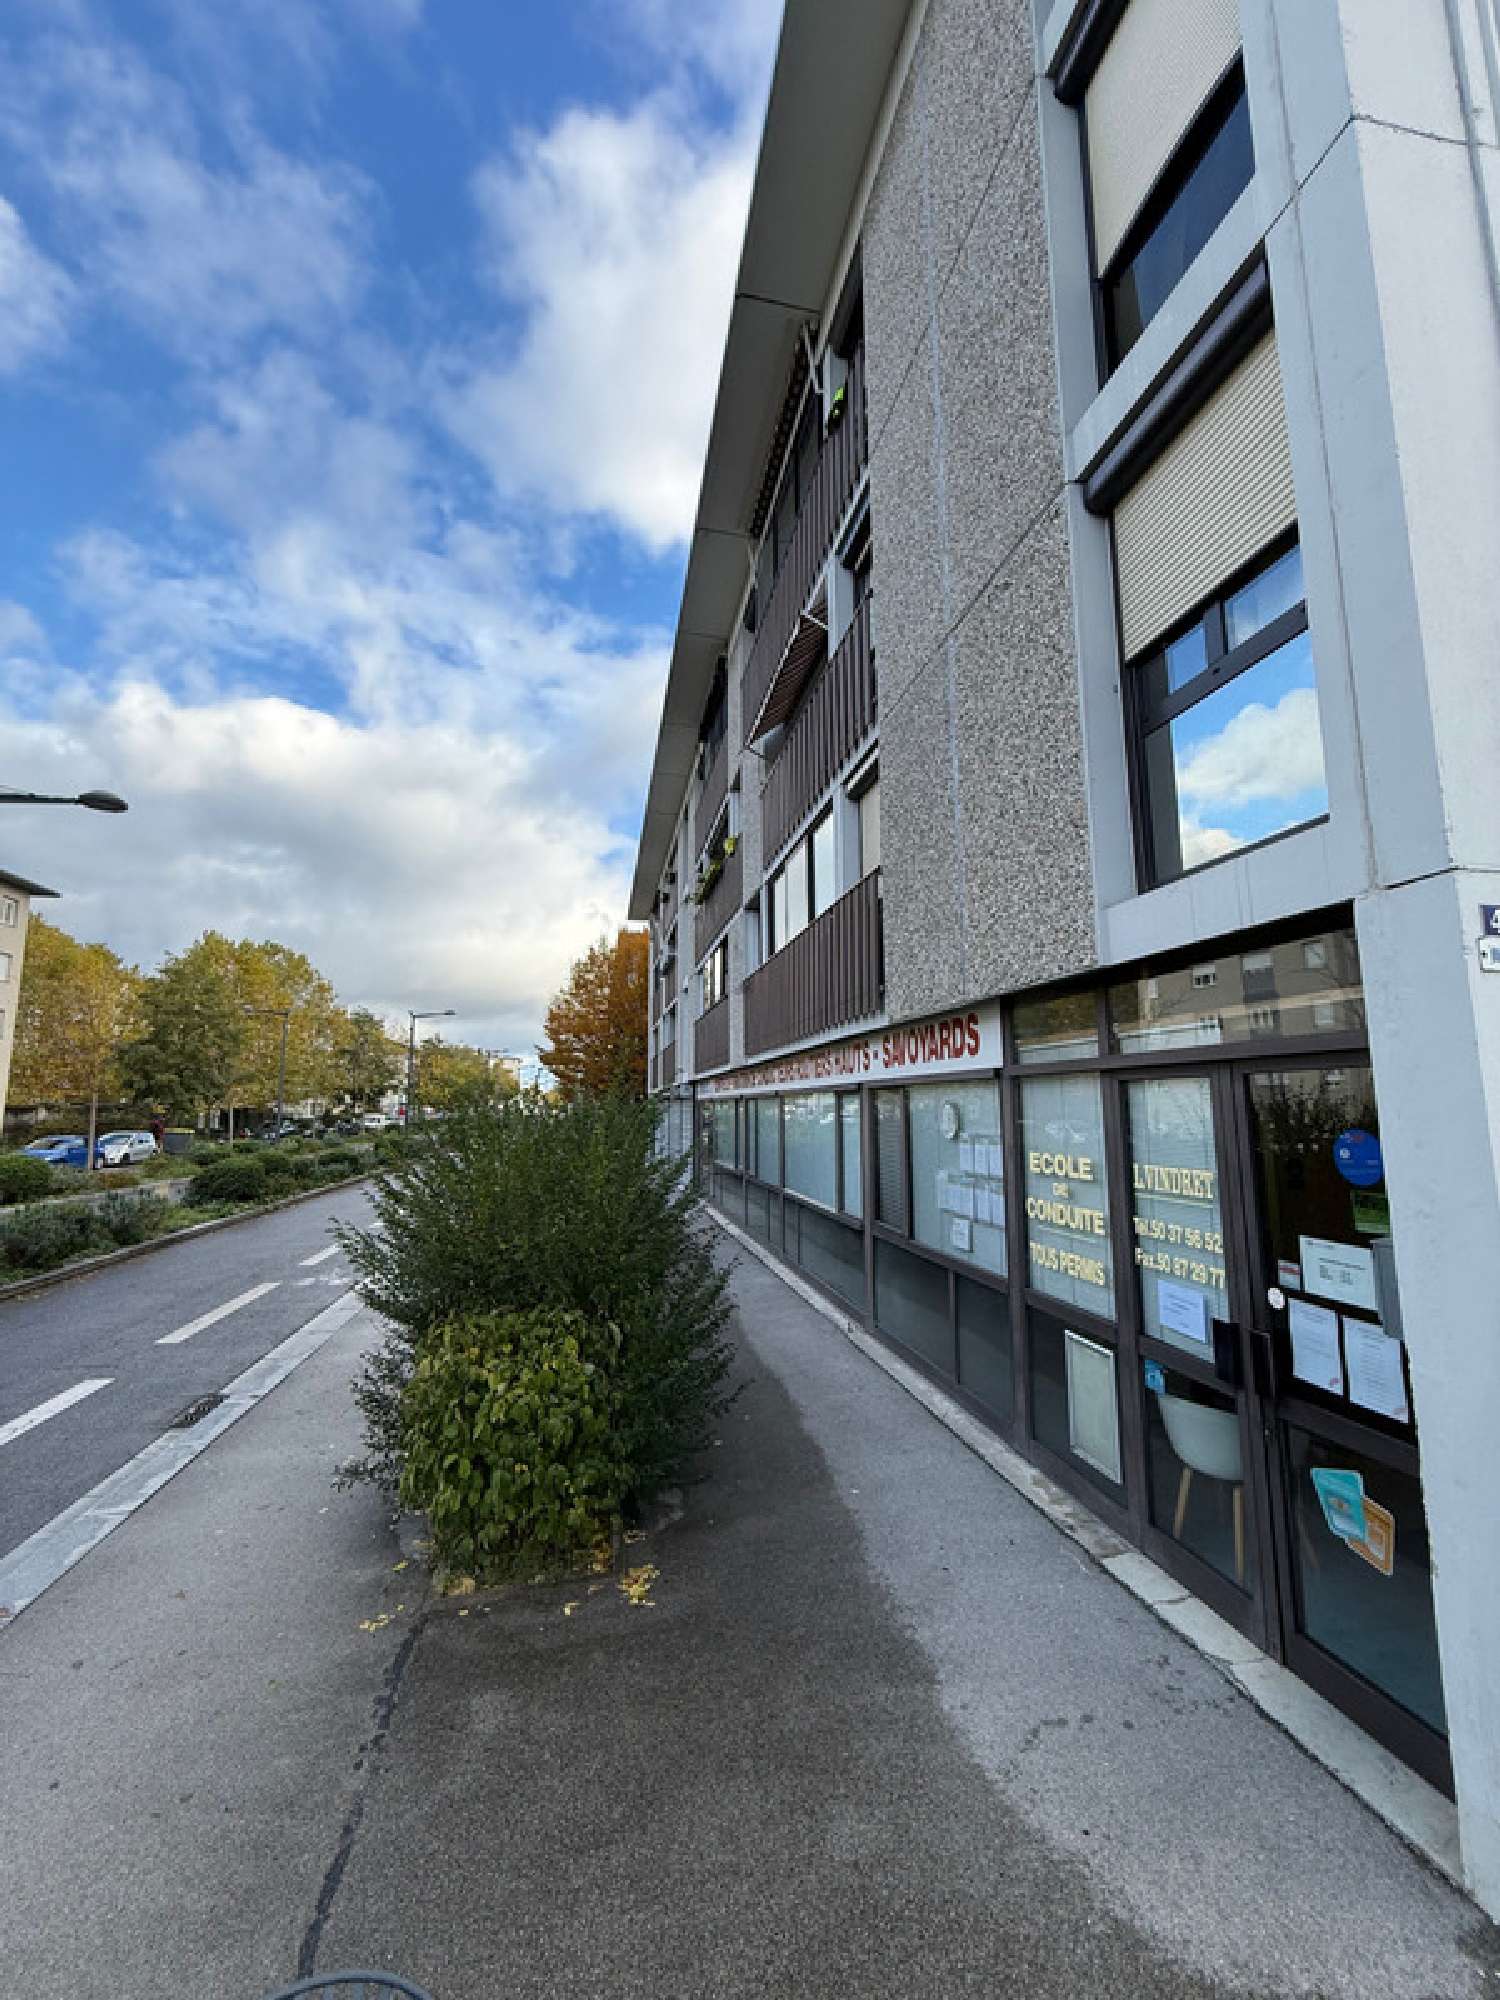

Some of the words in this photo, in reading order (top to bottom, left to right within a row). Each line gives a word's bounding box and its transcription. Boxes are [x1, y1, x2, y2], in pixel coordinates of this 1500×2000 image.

[882, 1012, 981, 1069] SAVOYARDS
[1030, 1152, 1094, 1181] ECOLE
[1027, 1197, 1106, 1236] CONDUITE
[1030, 1240, 1058, 1270] TOUS
[1059, 1248, 1105, 1286] PERMIS
